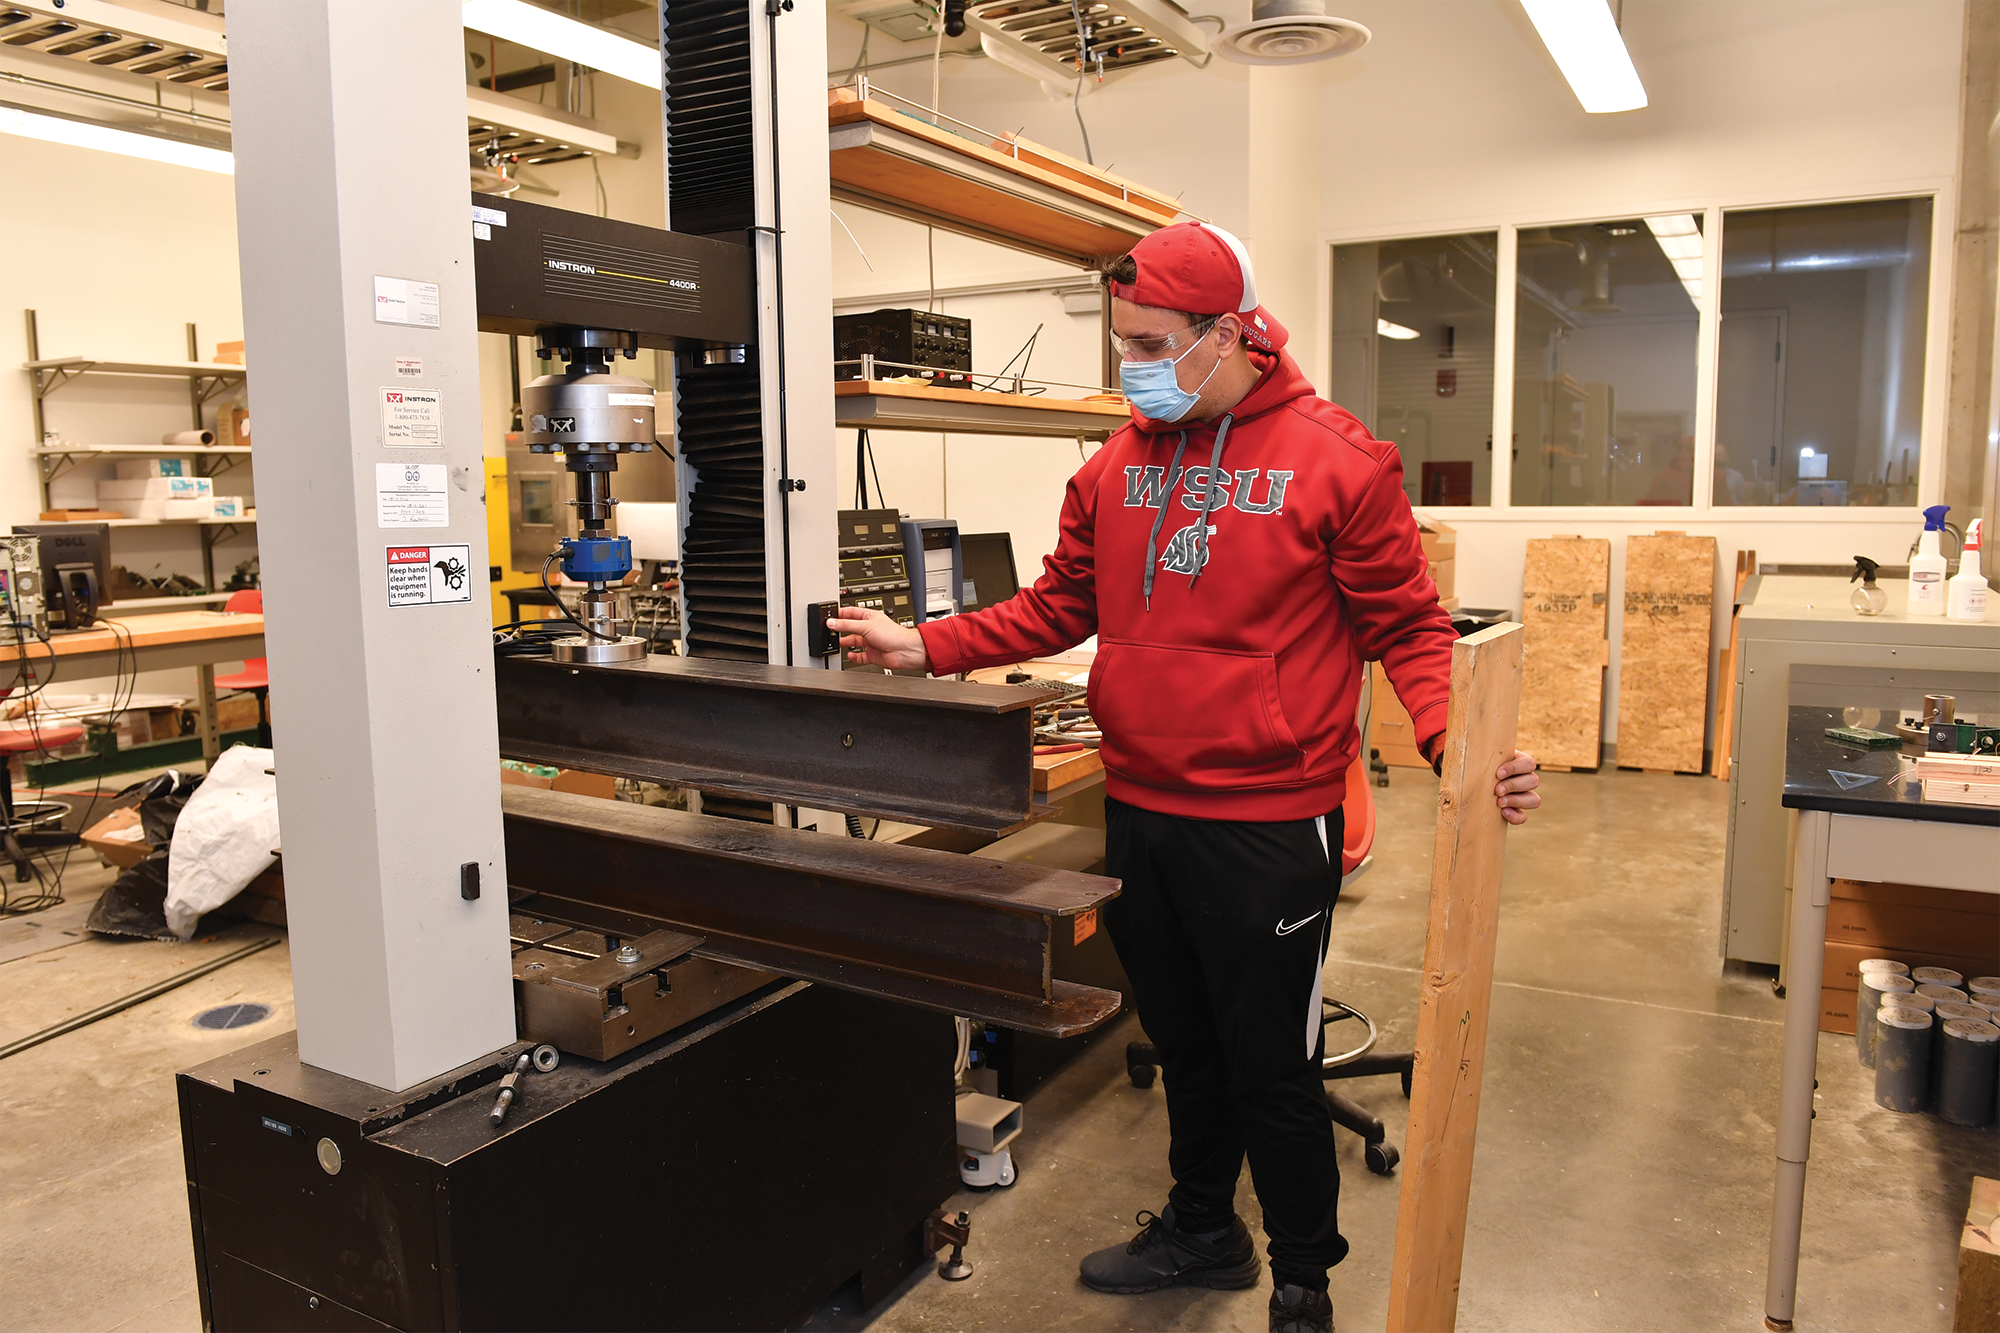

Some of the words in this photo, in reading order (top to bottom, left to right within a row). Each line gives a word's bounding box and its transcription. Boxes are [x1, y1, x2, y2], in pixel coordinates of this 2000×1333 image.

[548, 260, 595, 275] INSTRON
[669, 279, 696, 290] 4400R
[1241, 322, 1272, 349] OUGARS
[1123, 465, 1294, 515] WSU
[55, 537, 86, 547] DELL
[400, 551, 427, 559] DANGER
[390, 567, 407, 575] Keep
[390, 583, 427, 591] equipment
[397, 591, 426, 599] running.
[1842, 924, 1867, 932] ni.com
[1825, 1010, 1850, 1019] ni.com
